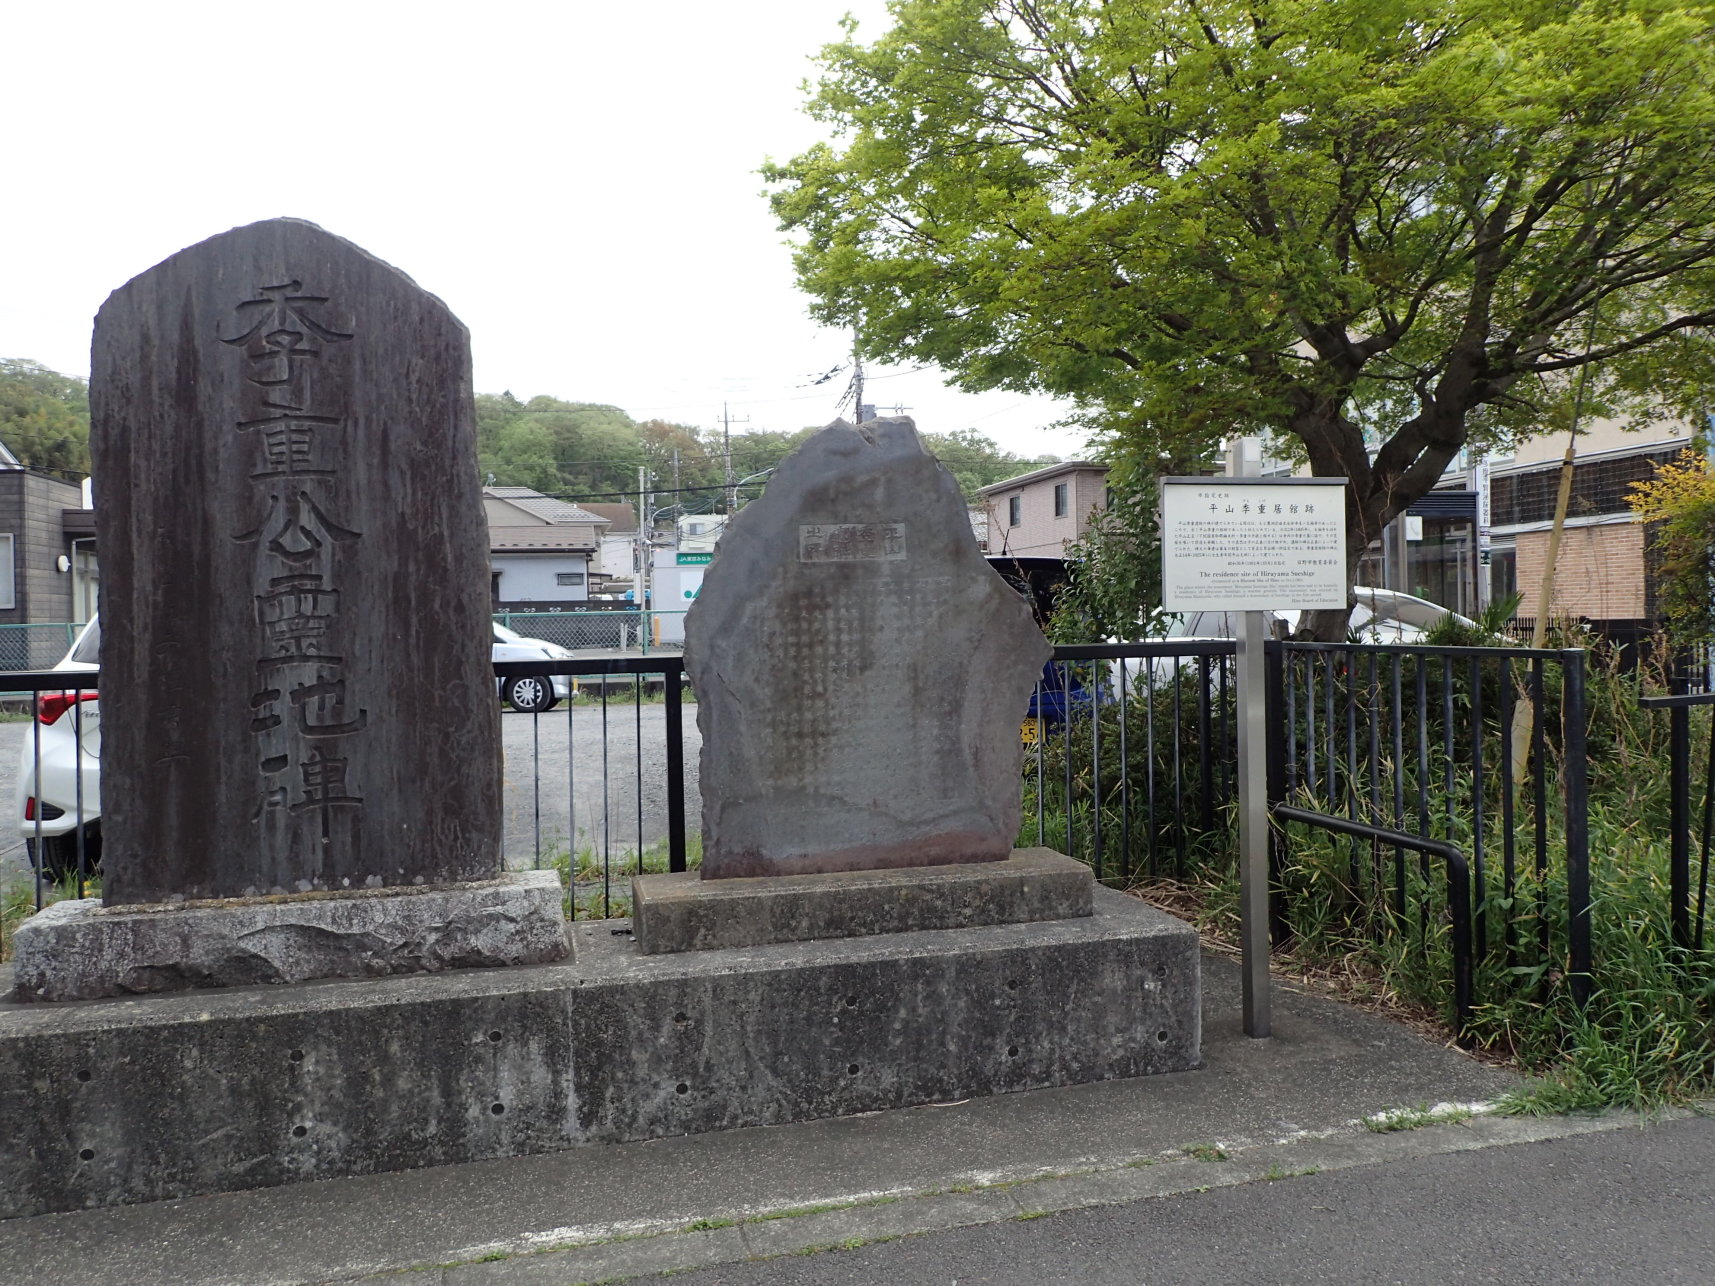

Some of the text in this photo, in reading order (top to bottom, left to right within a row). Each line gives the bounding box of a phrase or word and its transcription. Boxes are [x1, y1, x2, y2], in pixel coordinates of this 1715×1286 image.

[1208, 503, 1315, 515] 平山季重居館跡
[1261, 571, 1290, 579] Hirayama
